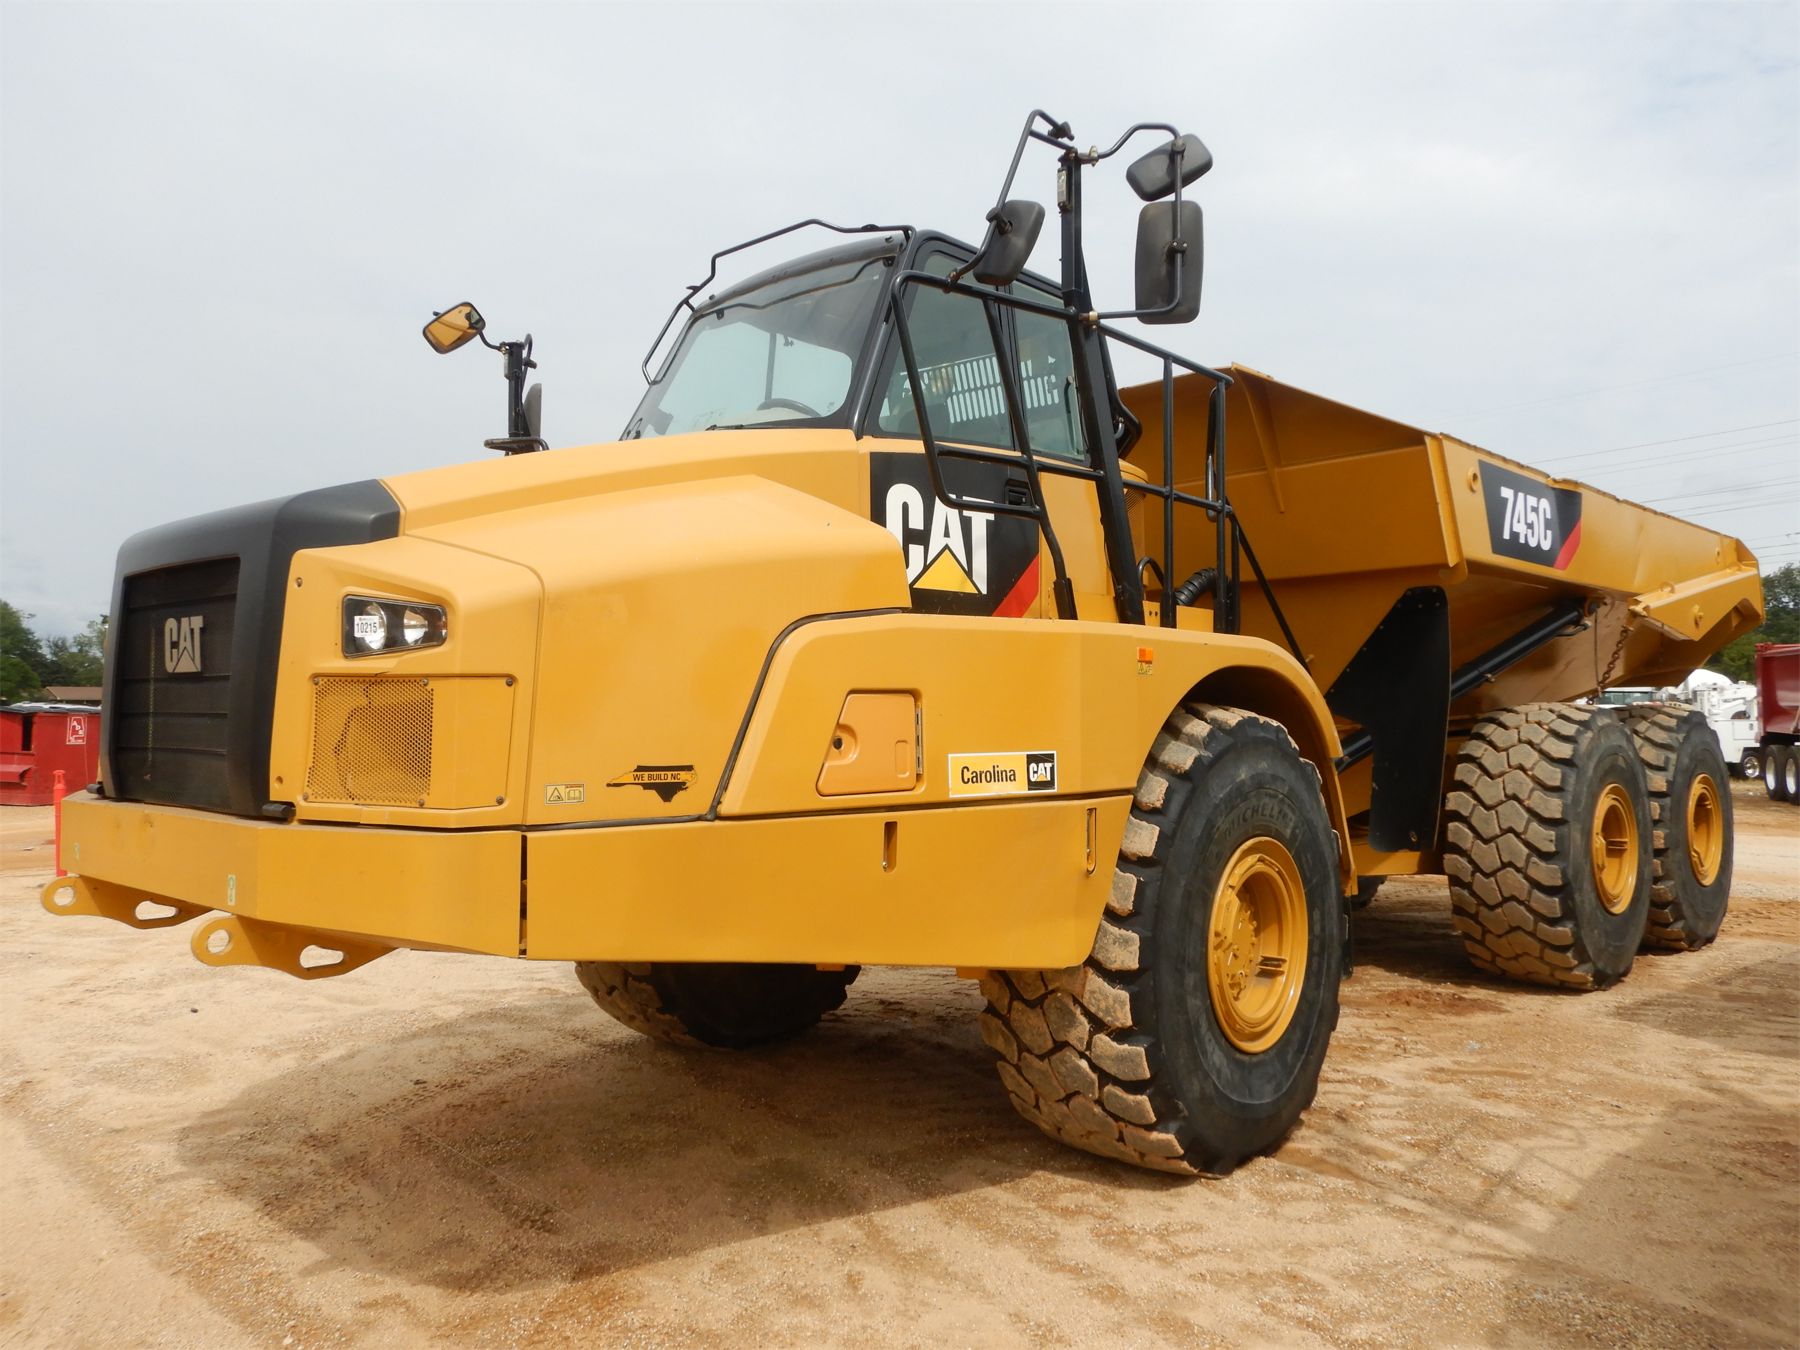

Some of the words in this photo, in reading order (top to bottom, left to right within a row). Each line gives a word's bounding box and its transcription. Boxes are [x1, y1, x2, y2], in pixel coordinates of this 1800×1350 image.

[886, 483, 995, 595] CAT
[1500, 486, 1552, 551] 745C
[164, 615, 204, 674] CAT
[356, 622, 378, 634] 10215
[633, 773, 645, 782] WE
[647, 773, 669, 781] BUILD
[670, 772, 681, 781] NC
[961, 765, 1017, 785] Carolina
[1029, 762, 1053, 782] CAT
